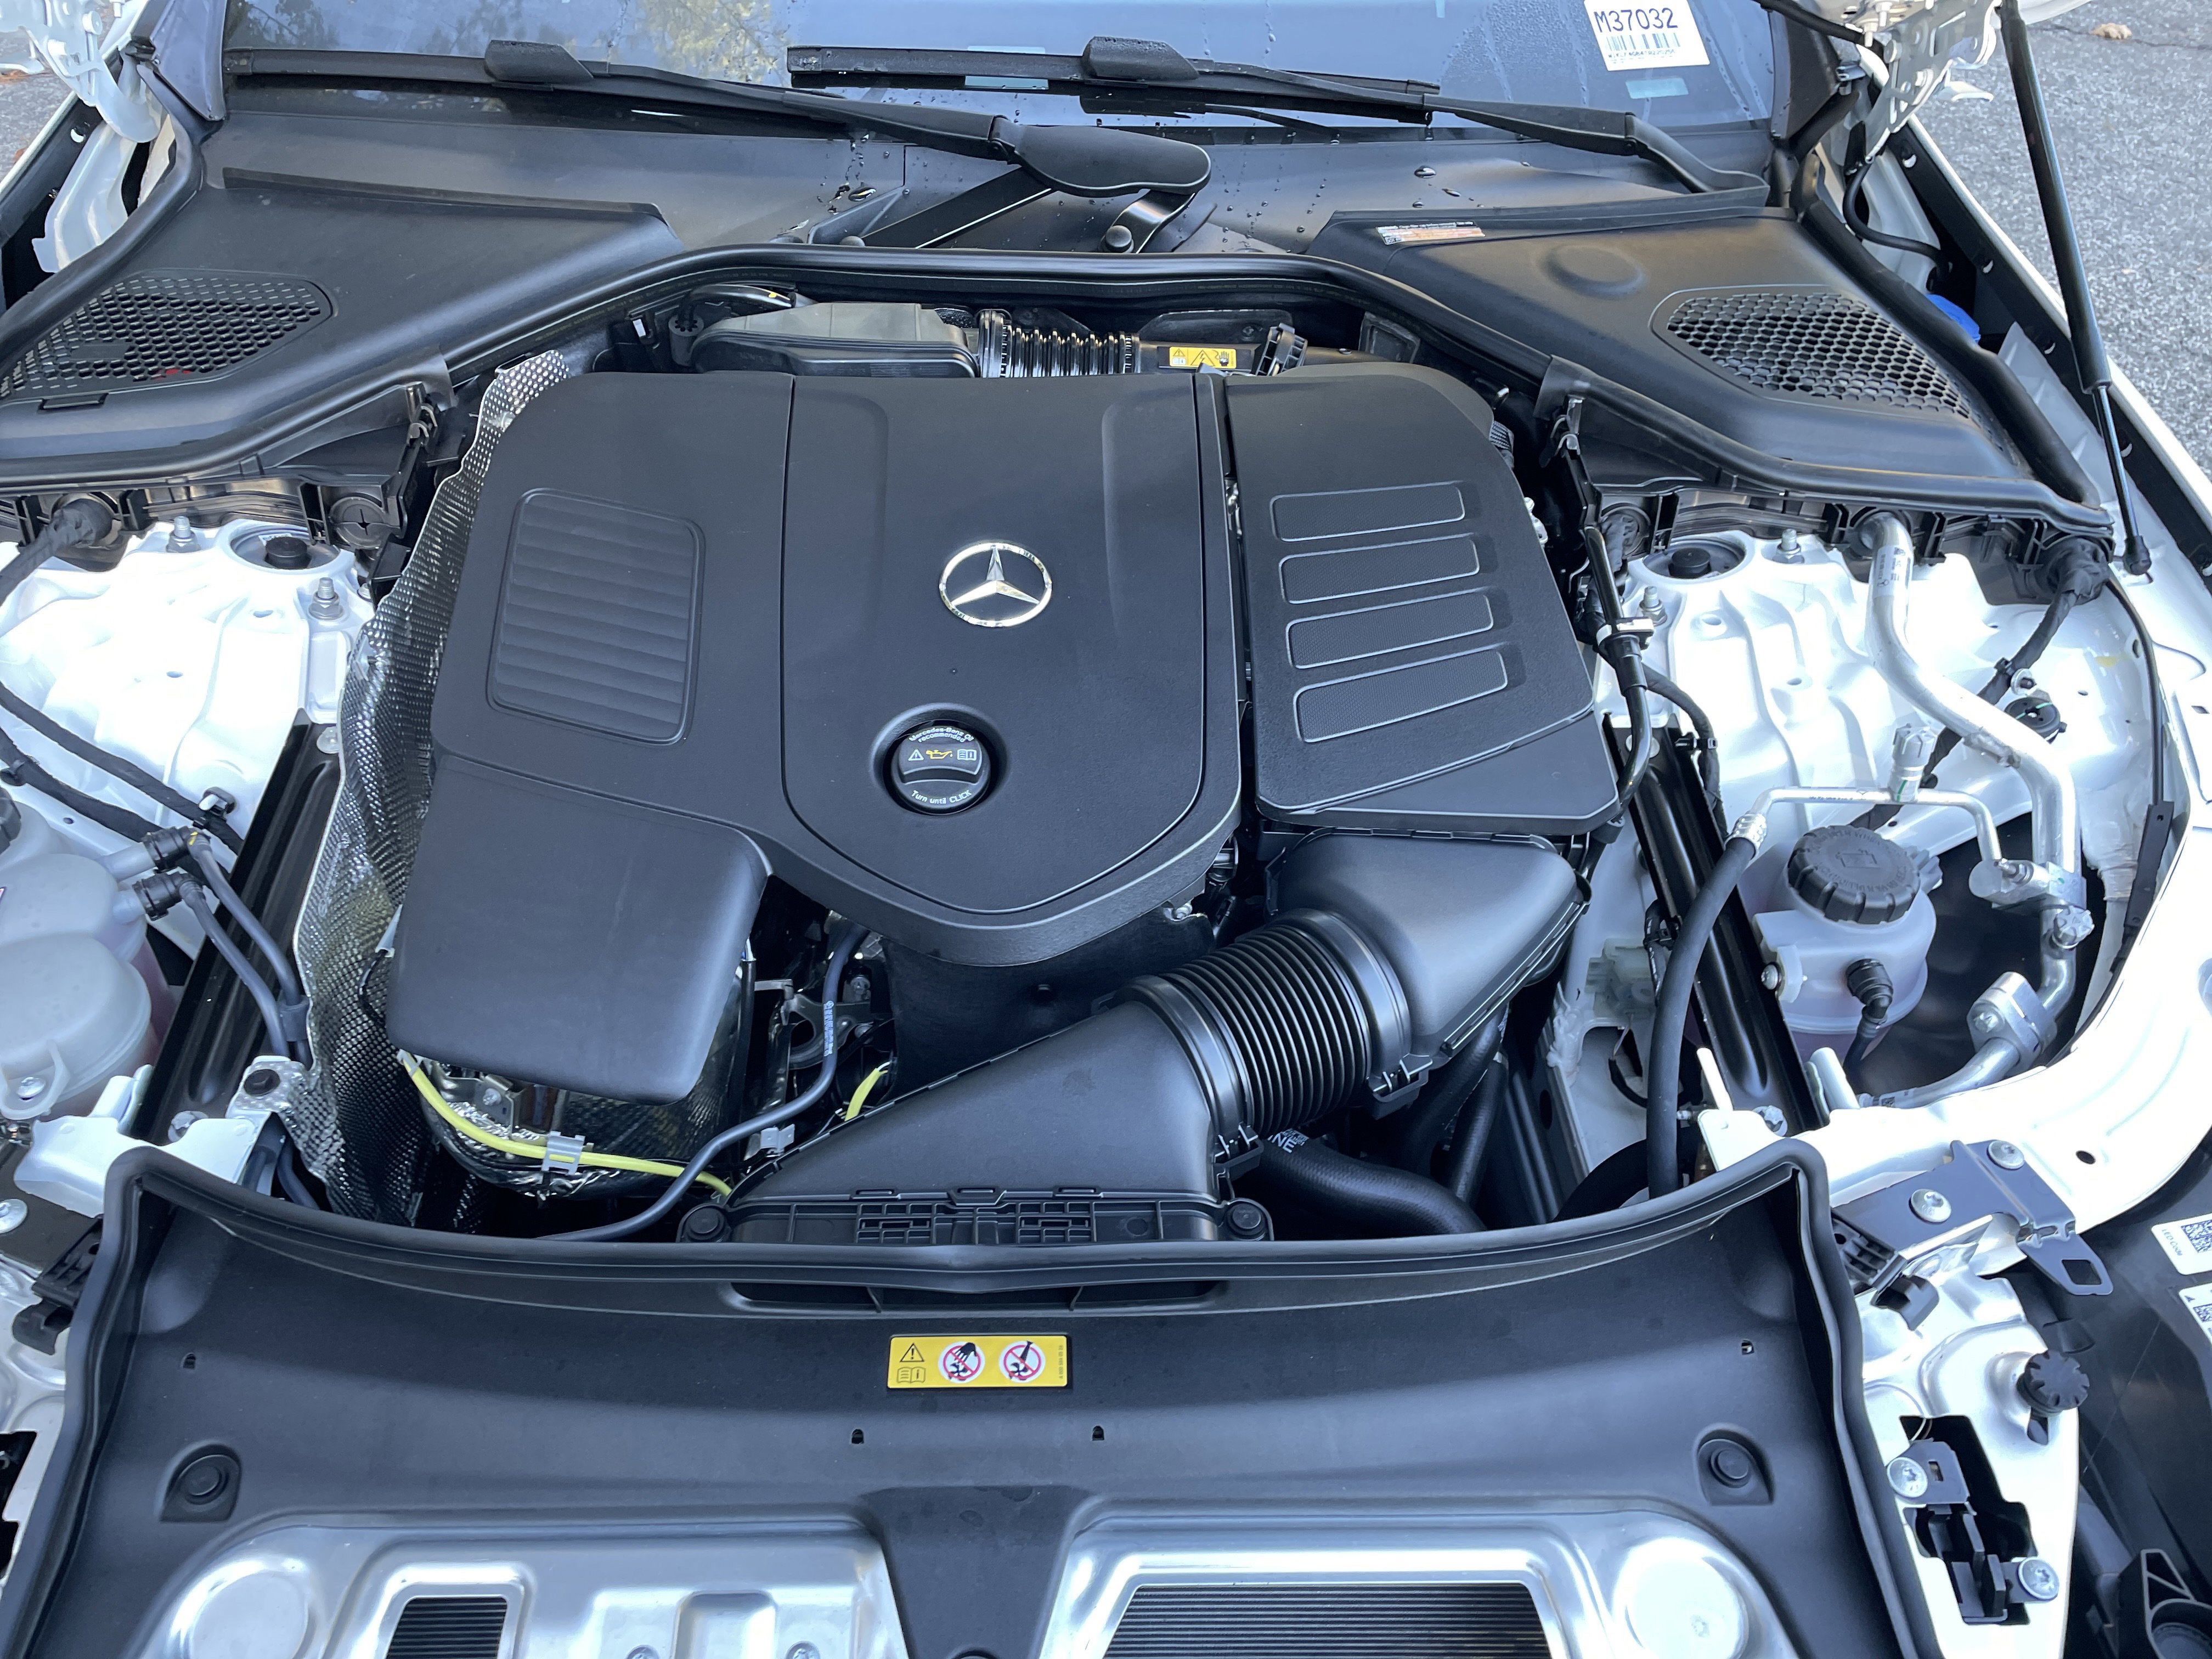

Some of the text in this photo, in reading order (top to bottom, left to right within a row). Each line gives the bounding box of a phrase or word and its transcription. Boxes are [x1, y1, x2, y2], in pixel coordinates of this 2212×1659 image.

[1594, 8, 1678, 33] M37032
[909, 727, 964, 741] Mercedes-Benz
[918, 732, 966, 743] recommended
[911, 790, 928, 802] Turn
[949, 789, 972, 803] CLICK
